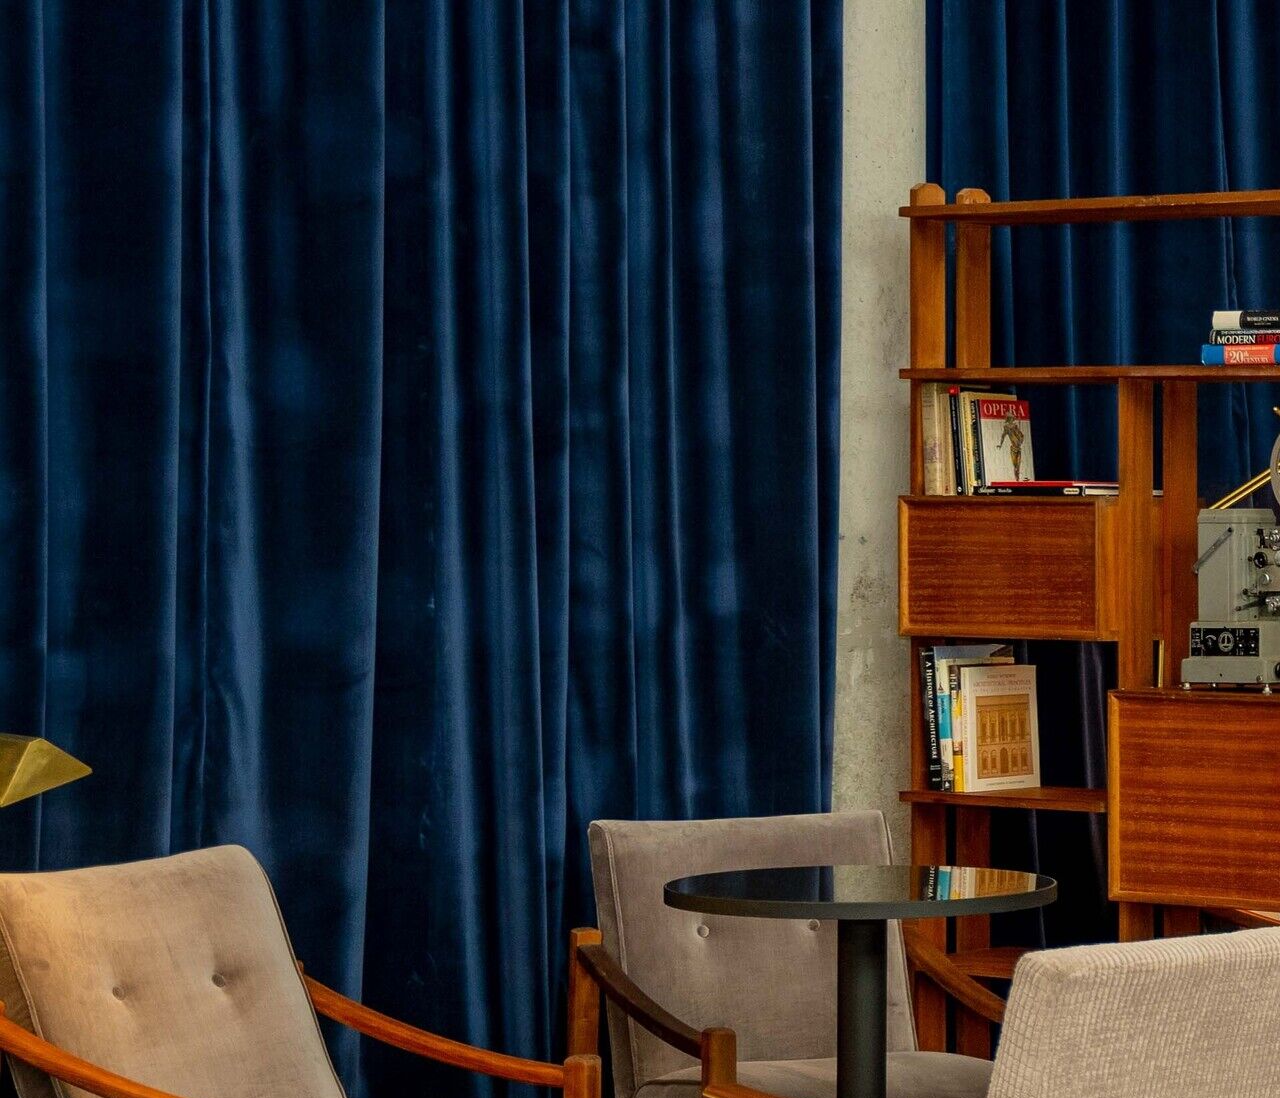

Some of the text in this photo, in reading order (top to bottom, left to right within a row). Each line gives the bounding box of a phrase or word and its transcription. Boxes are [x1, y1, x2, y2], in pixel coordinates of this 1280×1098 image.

[1217, 334, 1256, 345] MODERN
[983, 402, 1025, 417] OPERA
[926, 669, 934, 698] HISTORY
[928, 709, 937, 759] ARCHITECTURE
